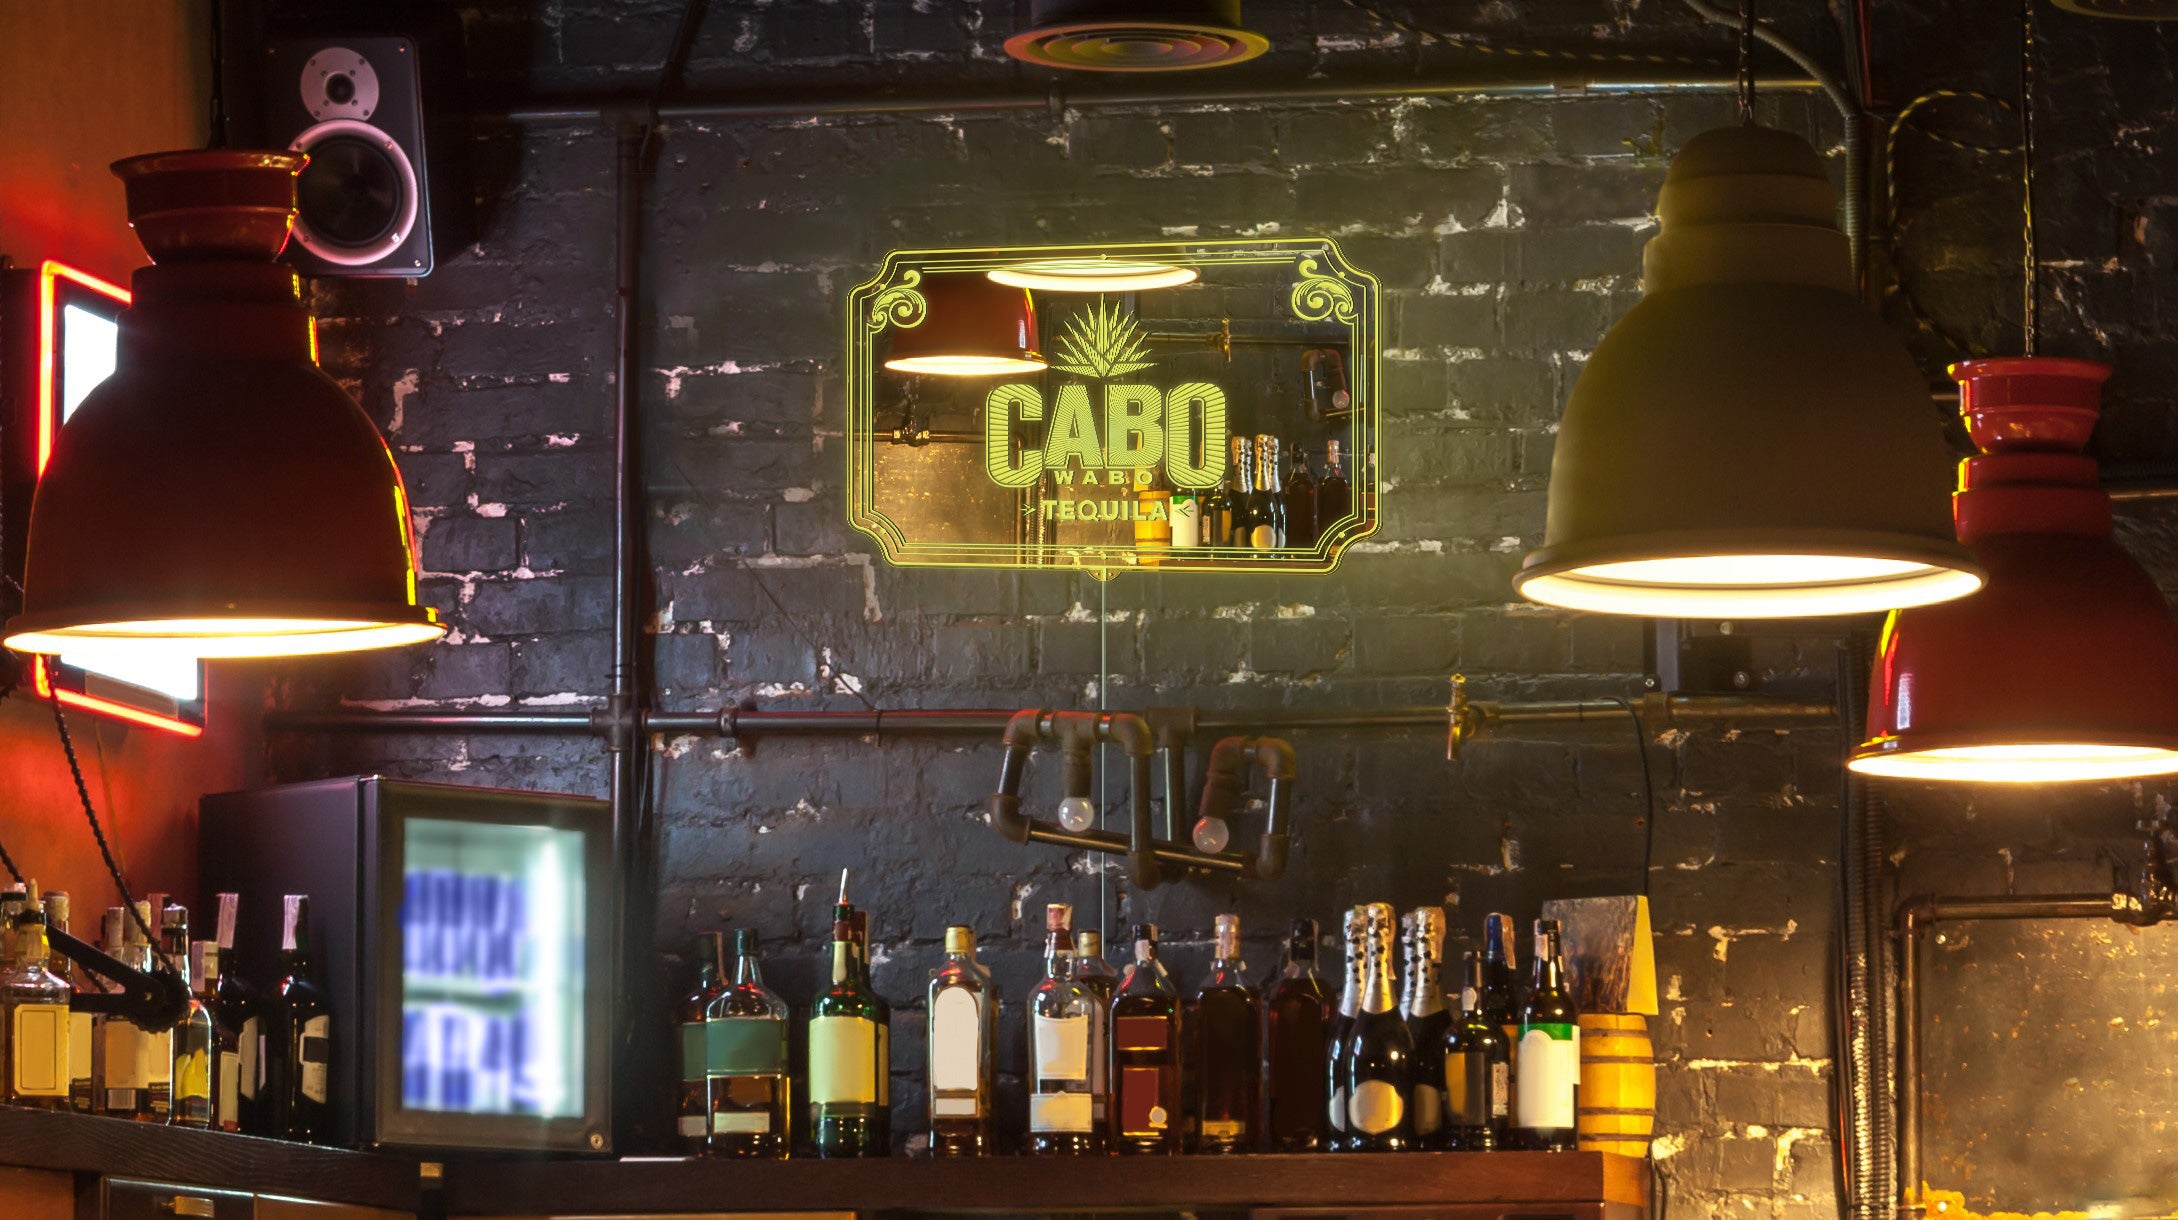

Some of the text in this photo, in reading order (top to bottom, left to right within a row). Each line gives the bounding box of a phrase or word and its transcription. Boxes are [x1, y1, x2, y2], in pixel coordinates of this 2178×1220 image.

[986, 383, 1226, 488] CABO
[1054, 470, 1153, 485] WABO
[1041, 500, 1168, 522] TEQUILA
